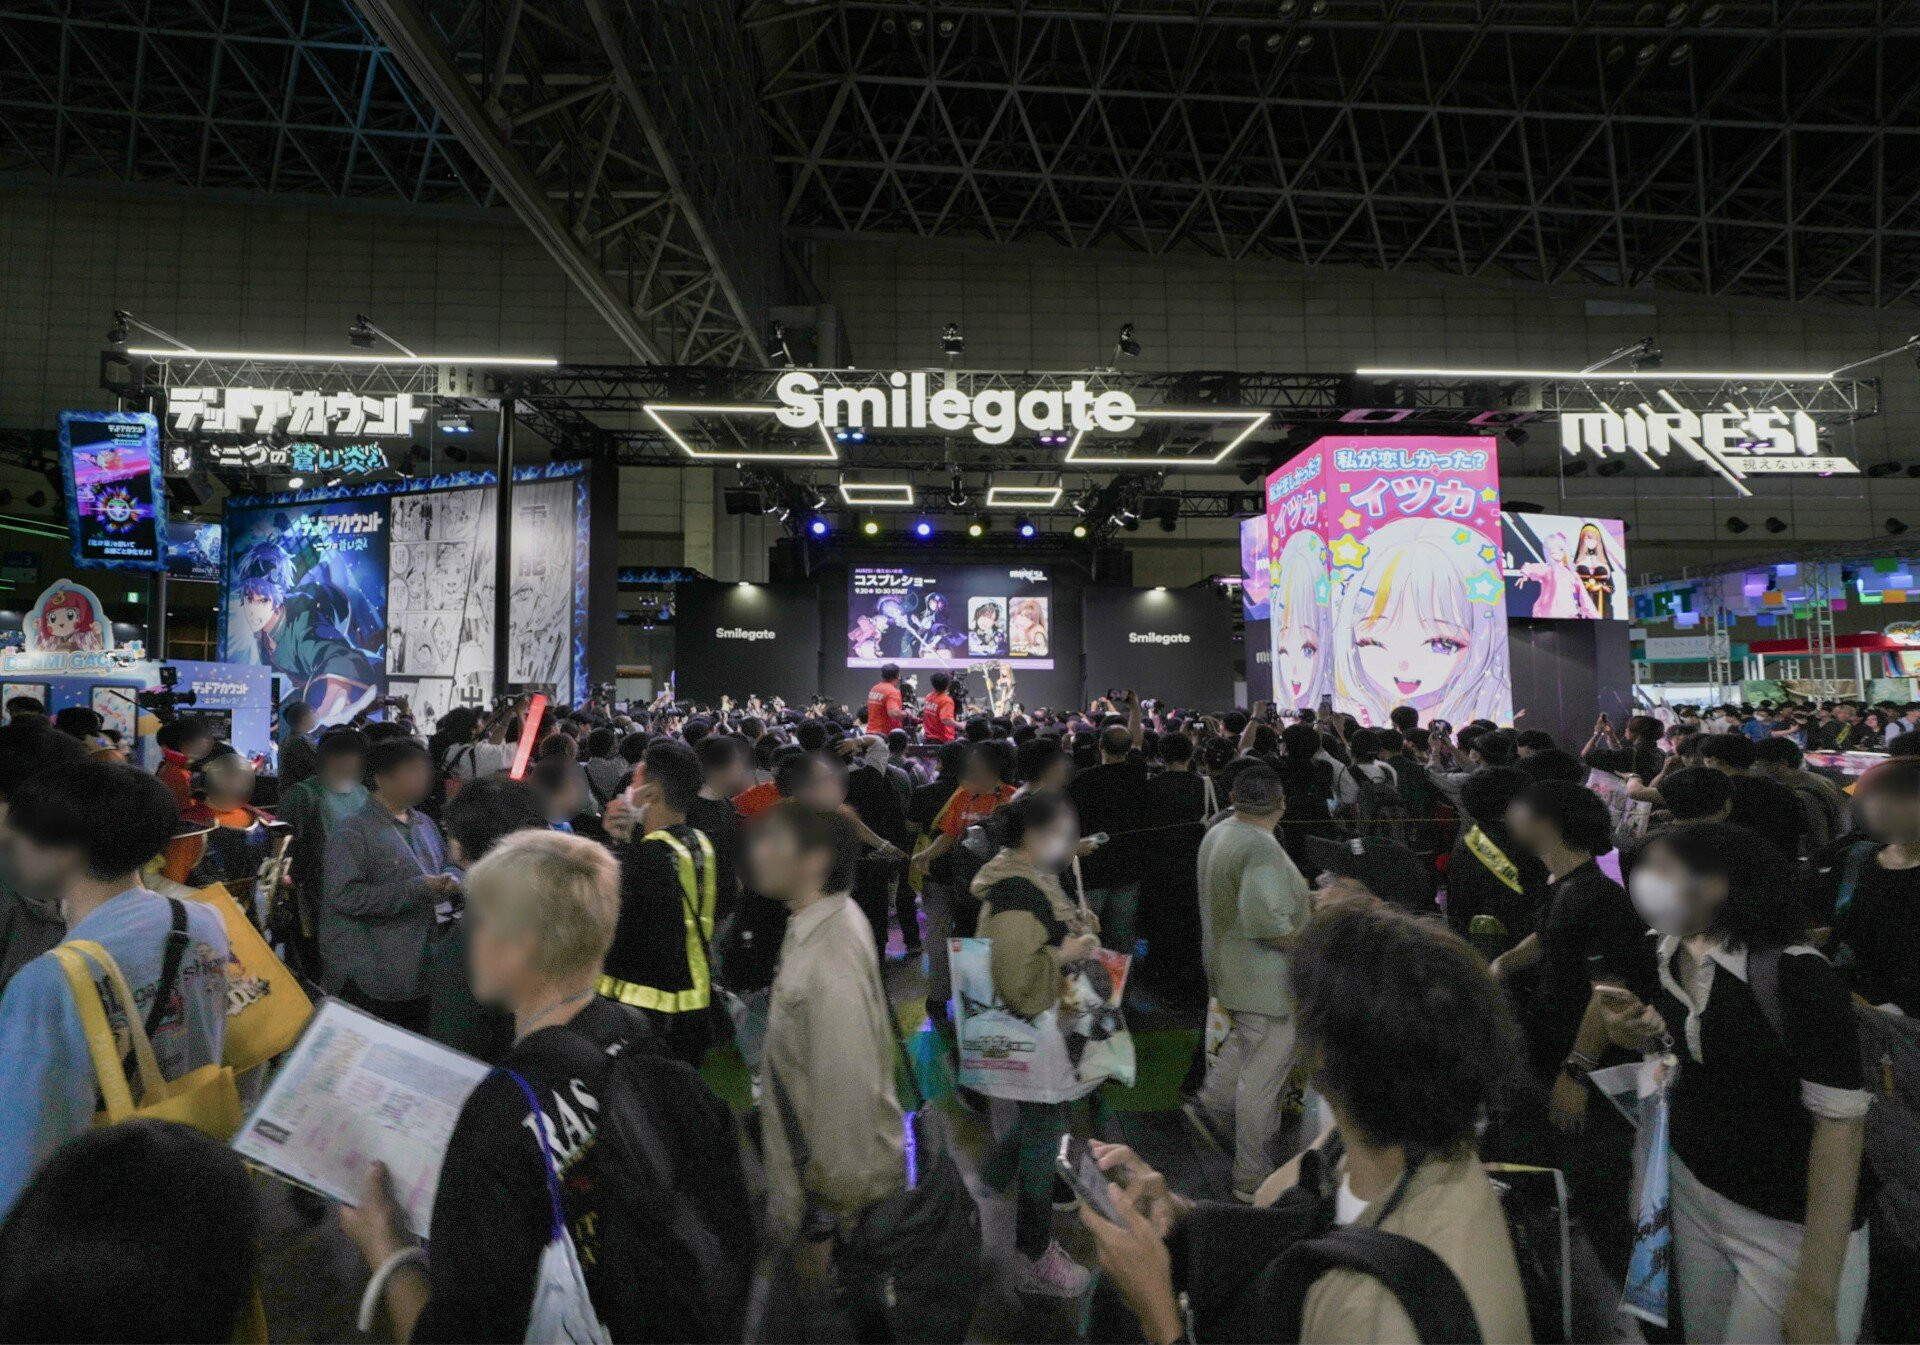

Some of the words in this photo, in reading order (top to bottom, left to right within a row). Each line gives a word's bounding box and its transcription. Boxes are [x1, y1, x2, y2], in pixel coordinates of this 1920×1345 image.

[168, 387, 428, 437] デッドアカウント
[776, 372, 1136, 443] Smilegate
[1561, 390, 1818, 493] MIRESI
[1336, 450, 1487, 471] 私が恋しかった?
[1742, 459, 1837, 470] 視えない未来
[1350, 477, 1476, 517] イツカ
[1274, 490, 1318, 538] イツカ
[854, 574, 936, 587] コスプレショー
[715, 627, 776, 641] Smilegate
[1128, 632, 1191, 645] Smilegate
